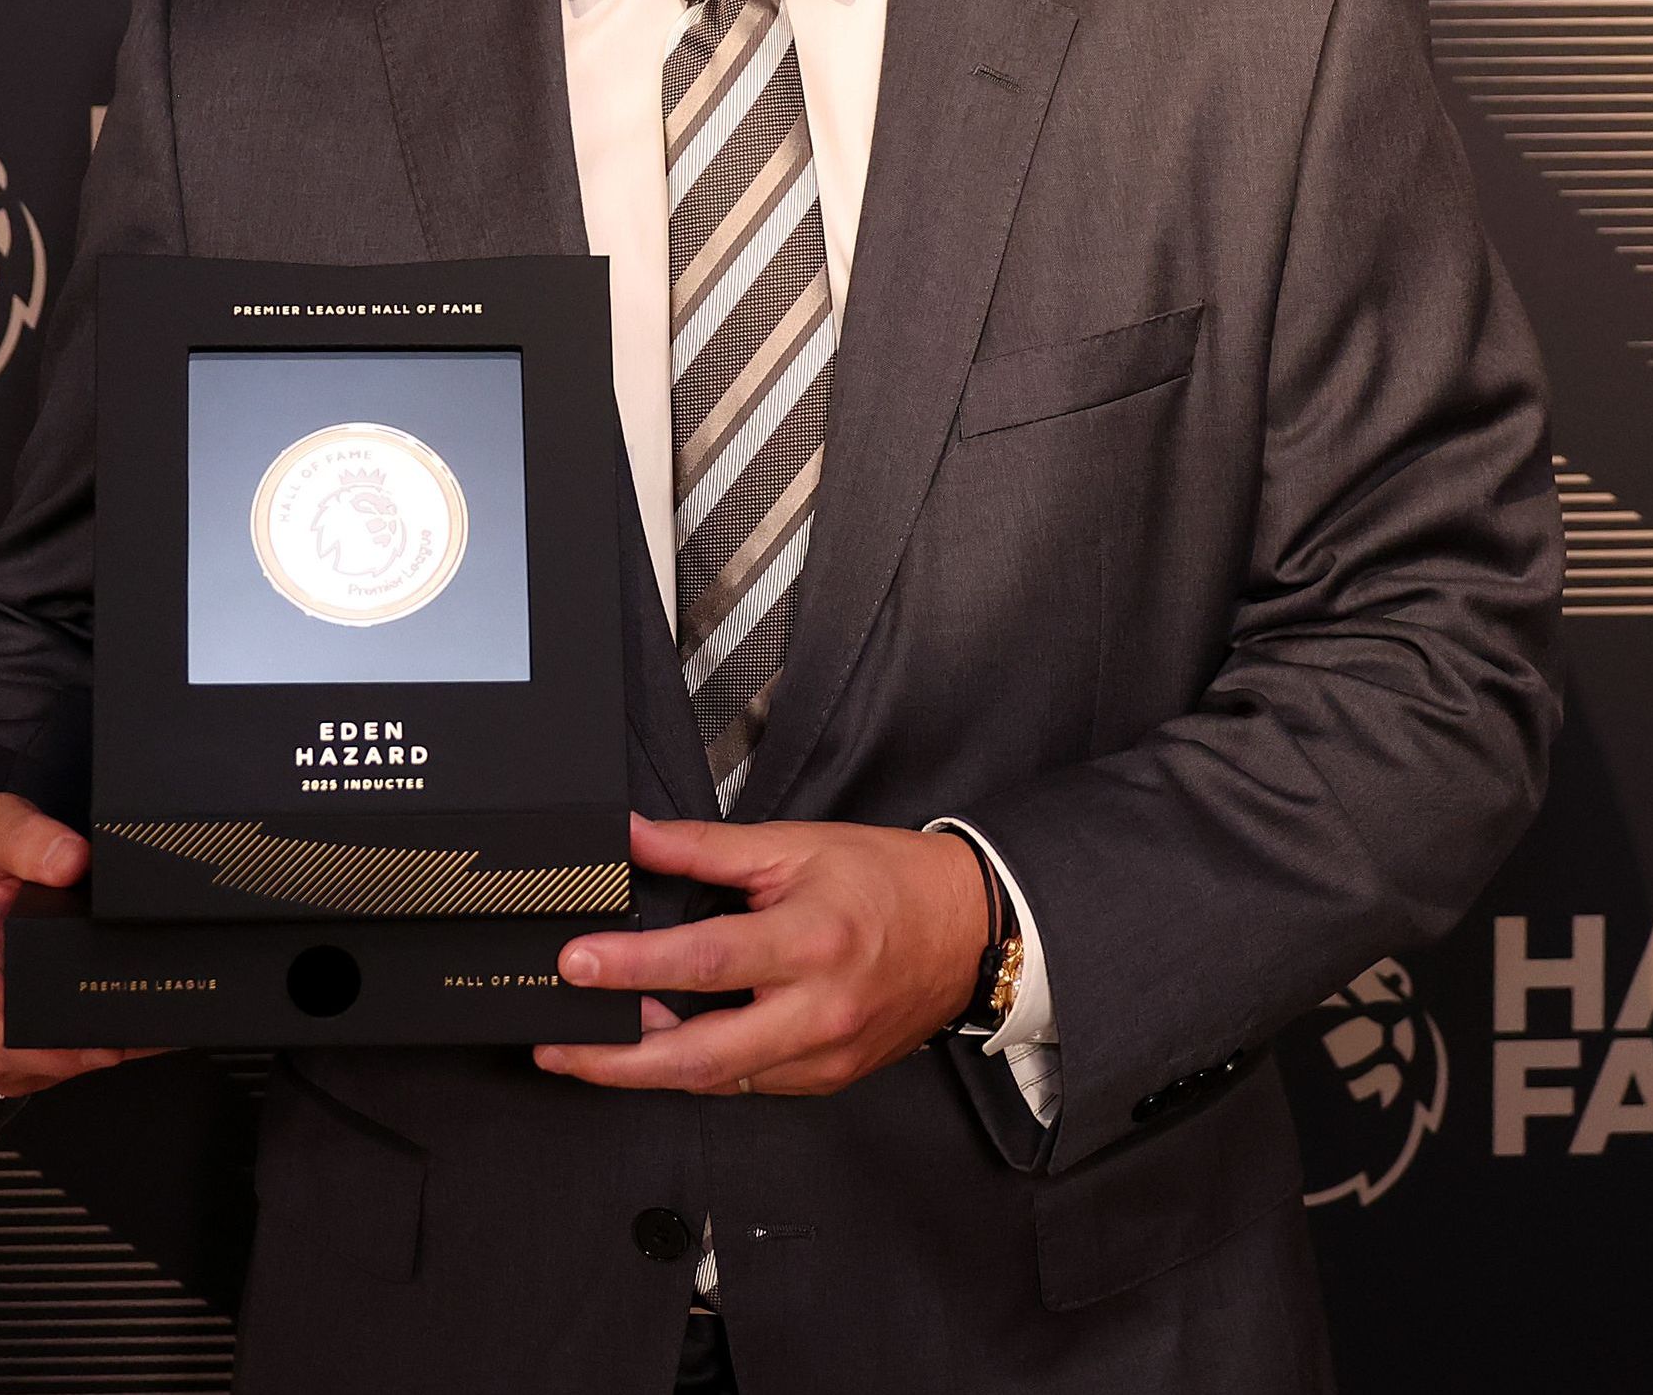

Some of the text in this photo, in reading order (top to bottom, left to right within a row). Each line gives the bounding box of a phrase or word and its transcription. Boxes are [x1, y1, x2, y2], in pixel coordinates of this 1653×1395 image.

[233, 303, 484, 316] PREMIER LEAGUE HALL OF FAME
[279, 449, 373, 523] HALL OF FAME
[319, 721, 404, 742] EDEN
[295, 745, 429, 767] HAZARD
[301, 777, 425, 792] 2025 INDUCTEE
[79, 979, 218, 992] PREMIER LEAGUE
[444, 975, 559, 987] HALL OF FAME
